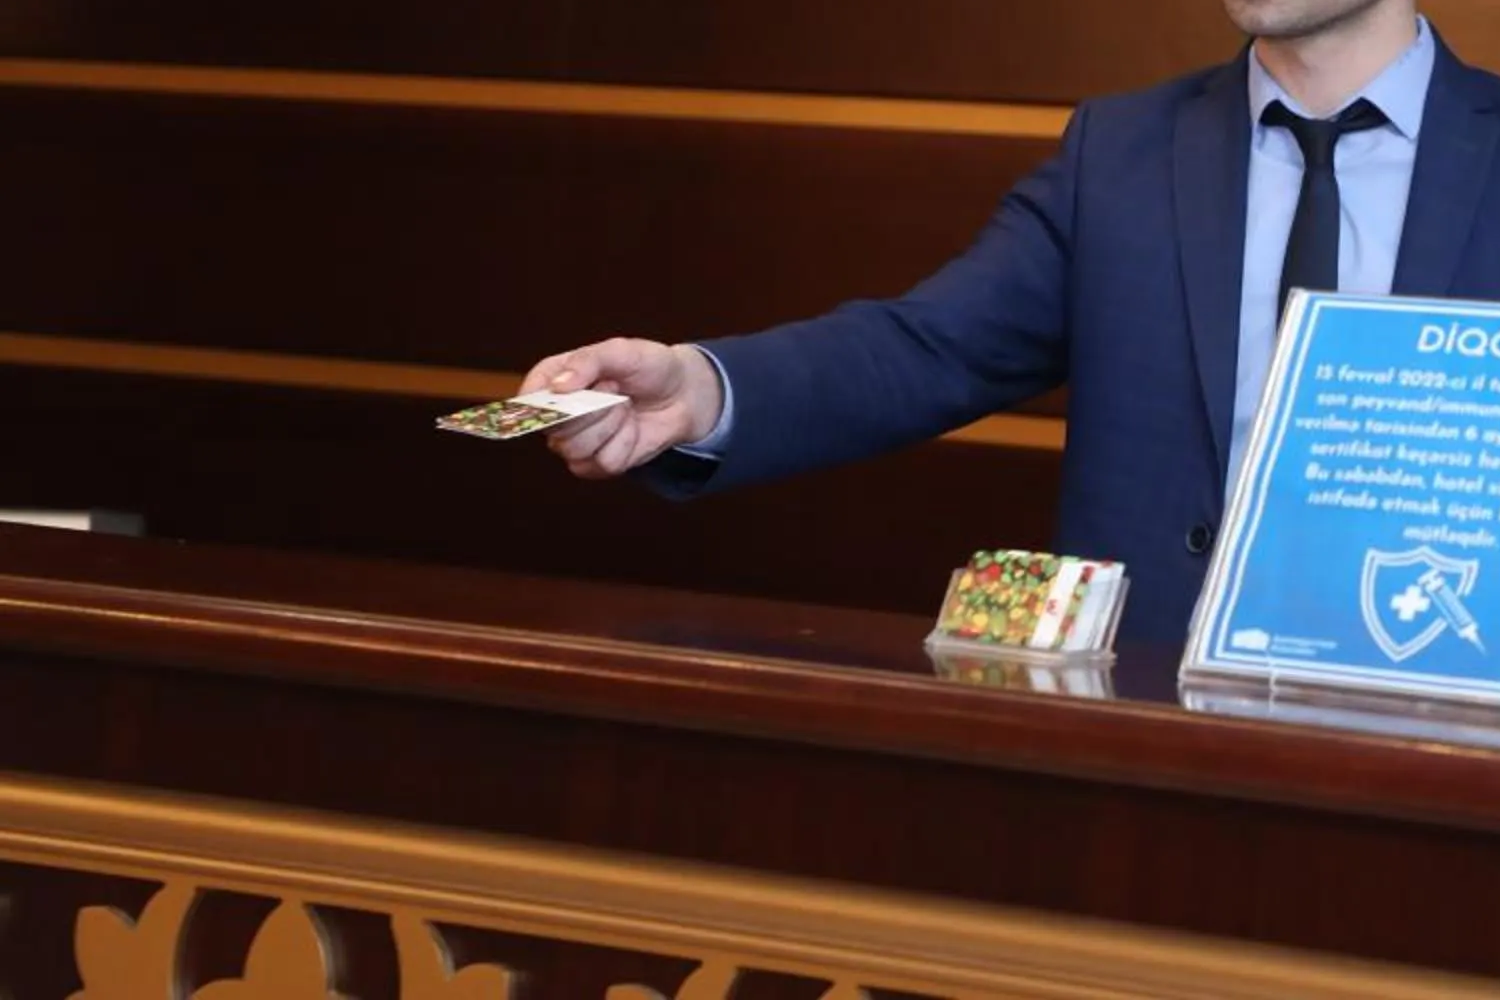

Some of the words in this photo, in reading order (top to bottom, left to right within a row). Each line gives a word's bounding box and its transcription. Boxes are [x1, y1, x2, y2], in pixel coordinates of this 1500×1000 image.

[1315, 363, 1333, 380] 15
[1338, 363, 1395, 384] fevral
[1398, 368, 1467, 391] 2022-ci
[1317, 392, 1347, 407] son
[1464, 425, 1478, 442] 6
[1310, 439, 1393, 460] sertifikat
[1304, 461, 1329, 481] Bu
[1433, 470, 1485, 493] hotel
